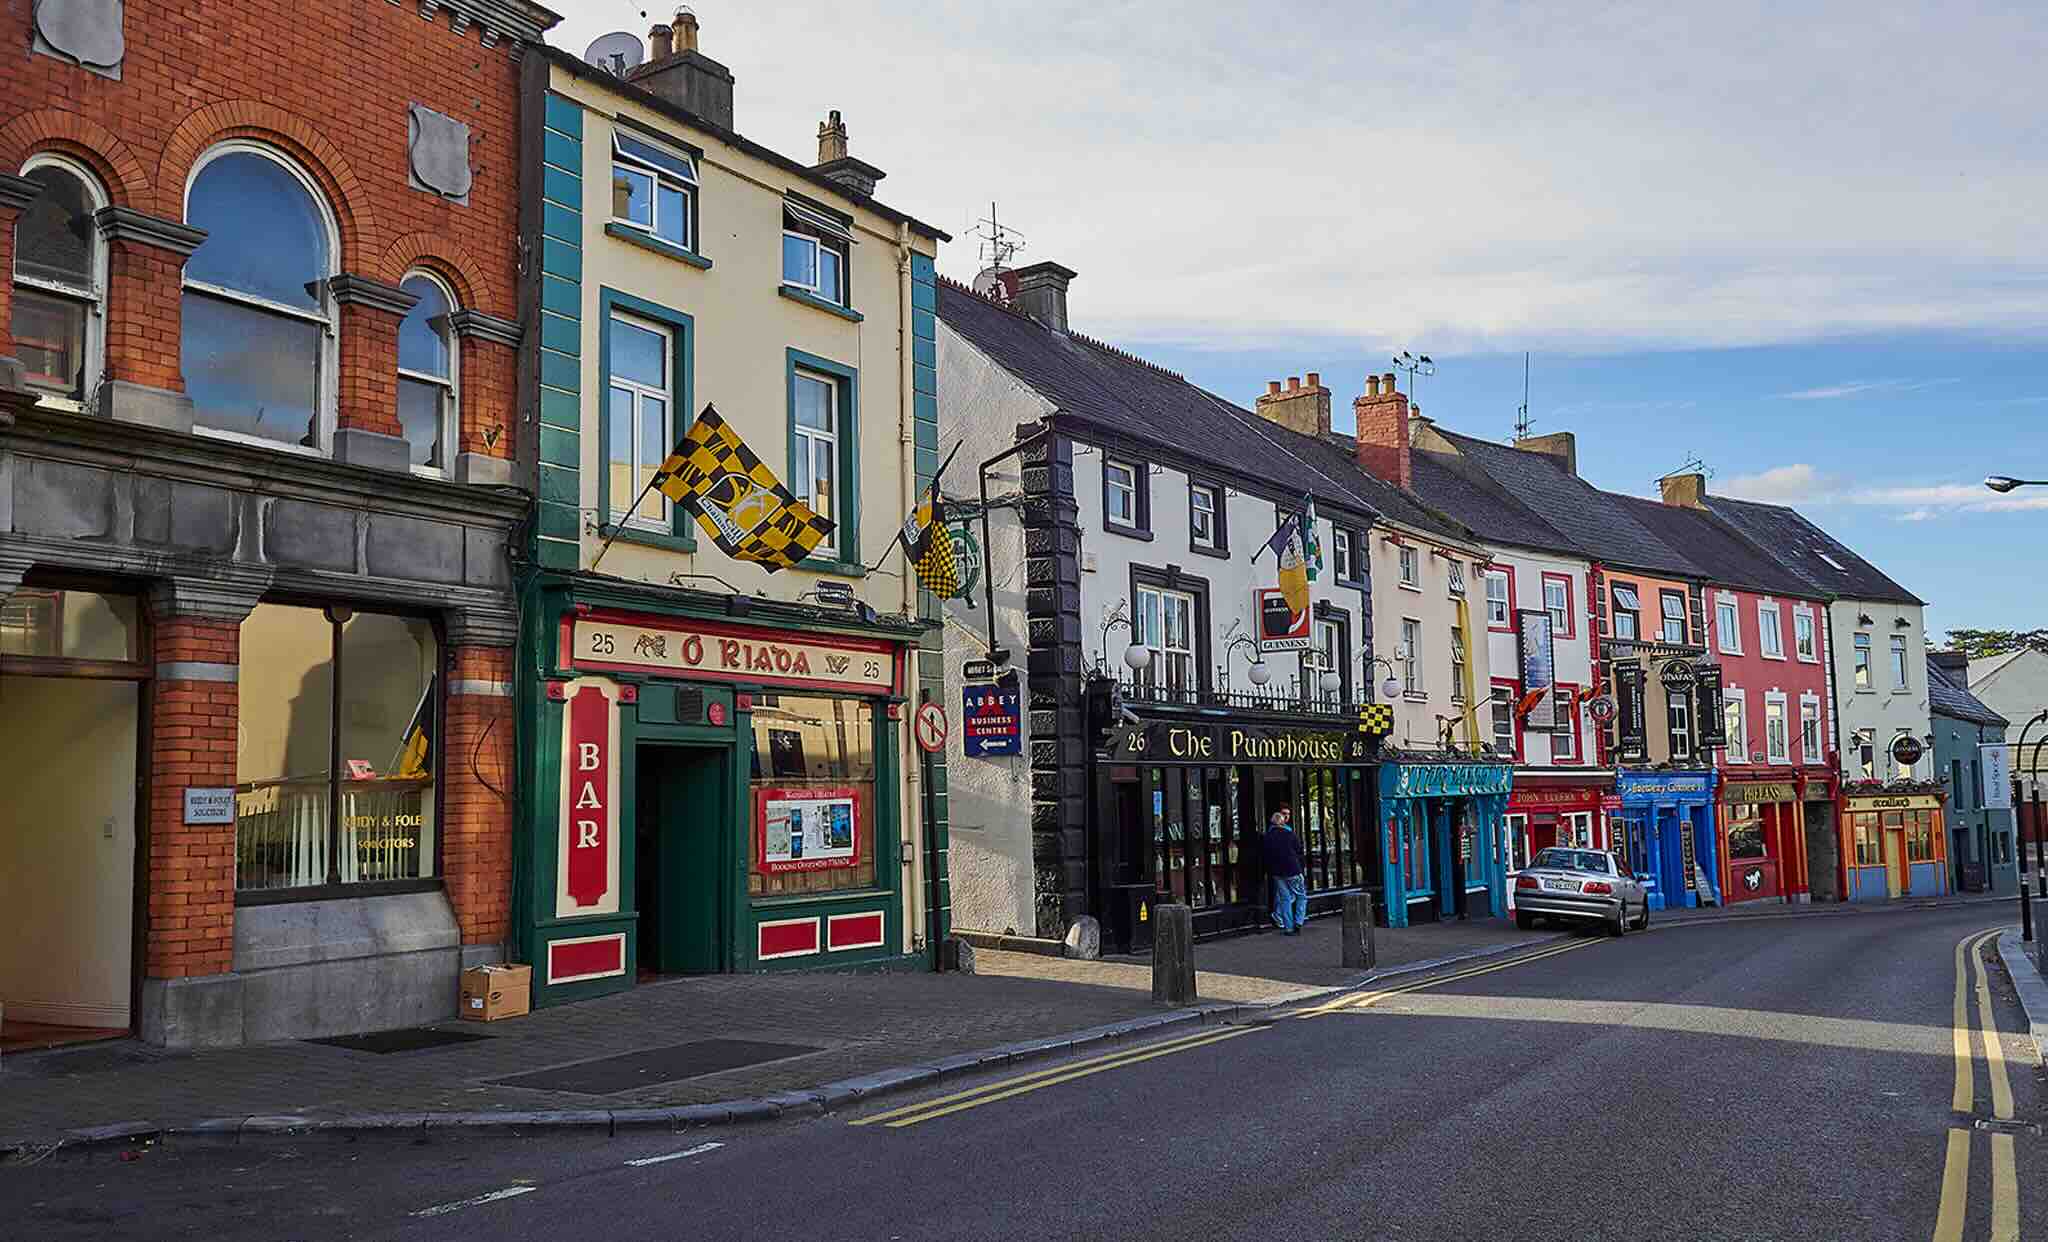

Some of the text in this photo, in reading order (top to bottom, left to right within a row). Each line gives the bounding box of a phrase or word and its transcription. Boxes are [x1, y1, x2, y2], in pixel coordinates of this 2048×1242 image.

[1263, 639, 1308, 649] GUINNESS
[591, 632, 614, 655] 25
[863, 660, 880, 680] 25
[965, 694, 1017, 708] ABBEY
[971, 715, 1012, 726] BUSINESS
[976, 726, 1009, 736] CENTRE
[1127, 728, 1364, 760] 26 The Pumphouse 26
[575, 742, 603, 849] BAR
[382, 816, 390, 827] &
